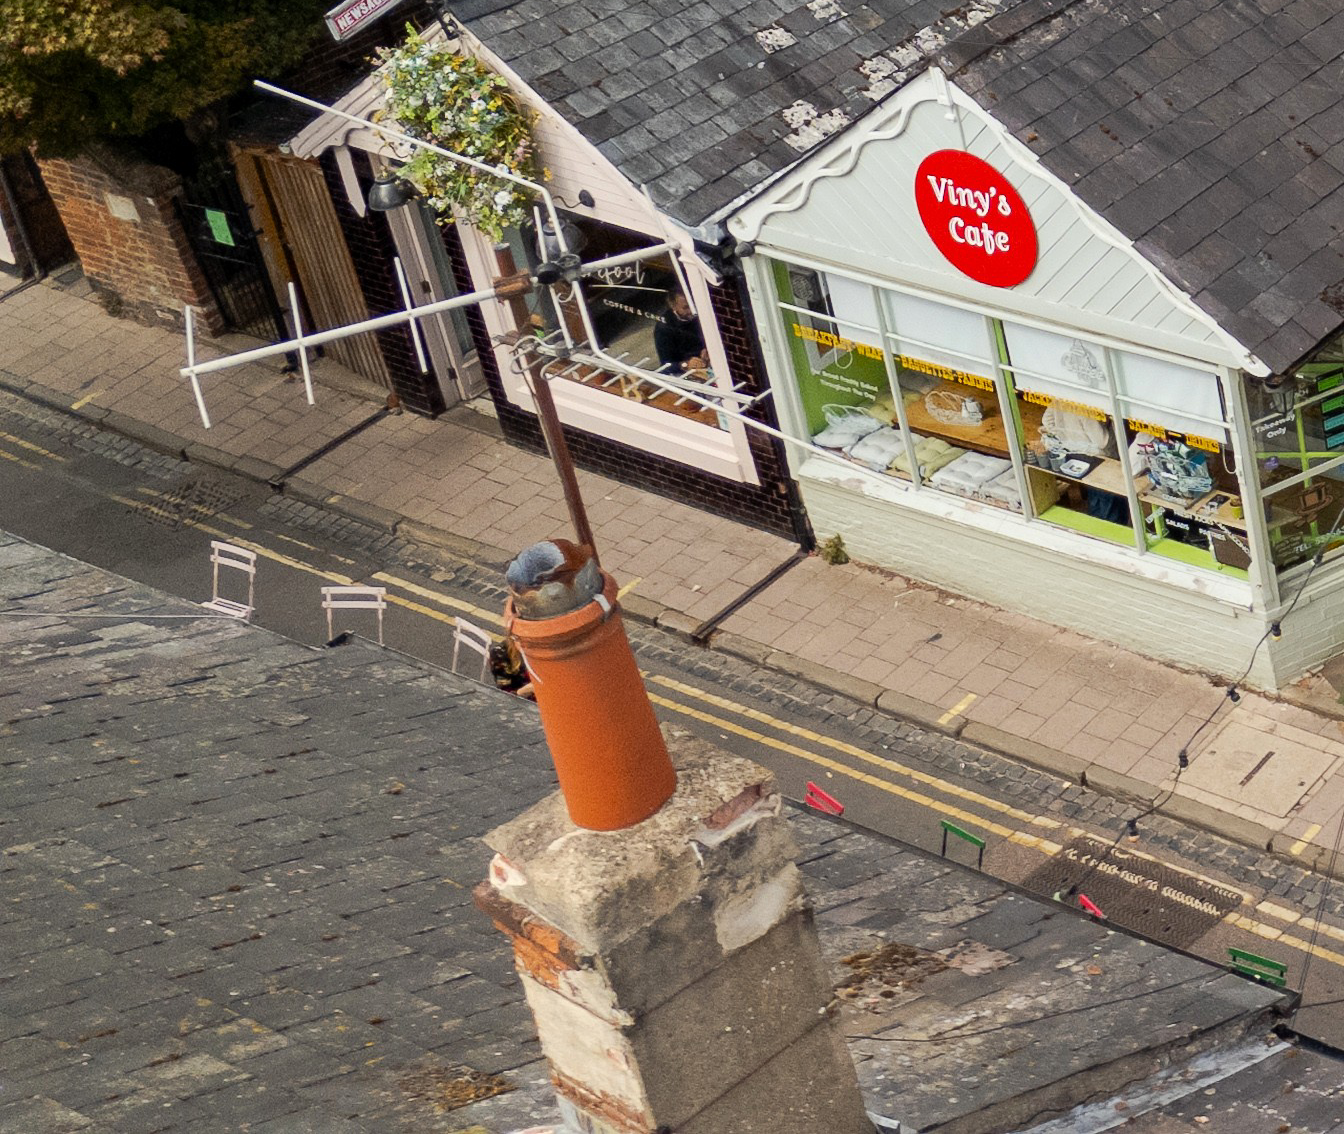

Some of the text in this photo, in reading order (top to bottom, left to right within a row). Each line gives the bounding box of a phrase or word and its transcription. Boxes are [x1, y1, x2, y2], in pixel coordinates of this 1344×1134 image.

[927, 175, 1012, 216] Viny's
[949, 216, 1010, 254] Cafe
[1256, 412, 1296, 433] Takeaway
[1267, 426, 1287, 438] Only
